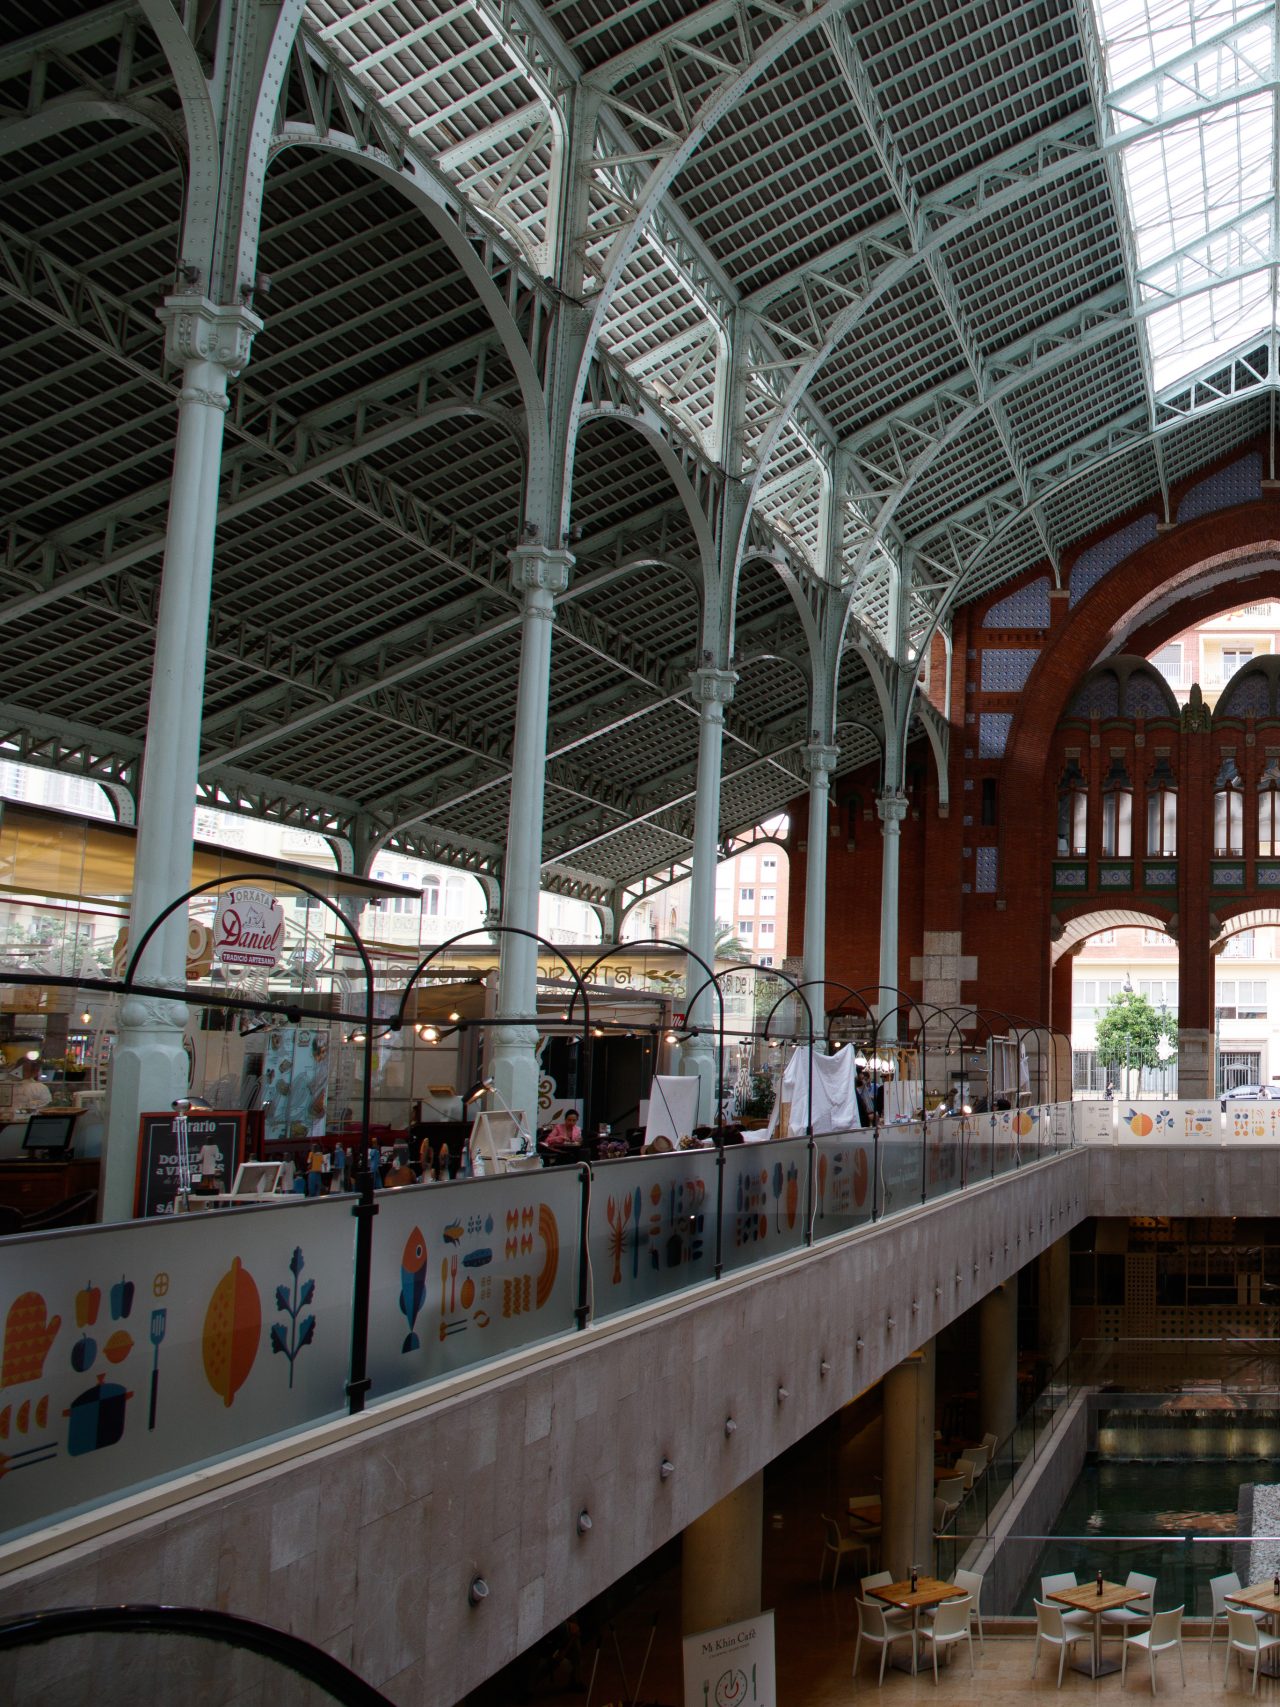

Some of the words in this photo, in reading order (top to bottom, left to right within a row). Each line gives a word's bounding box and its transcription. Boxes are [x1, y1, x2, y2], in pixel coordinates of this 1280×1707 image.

[236, 890, 270, 905] ORXATA
[216, 908, 281, 951] Daniel
[249, 955, 275, 965] ARTESANA
